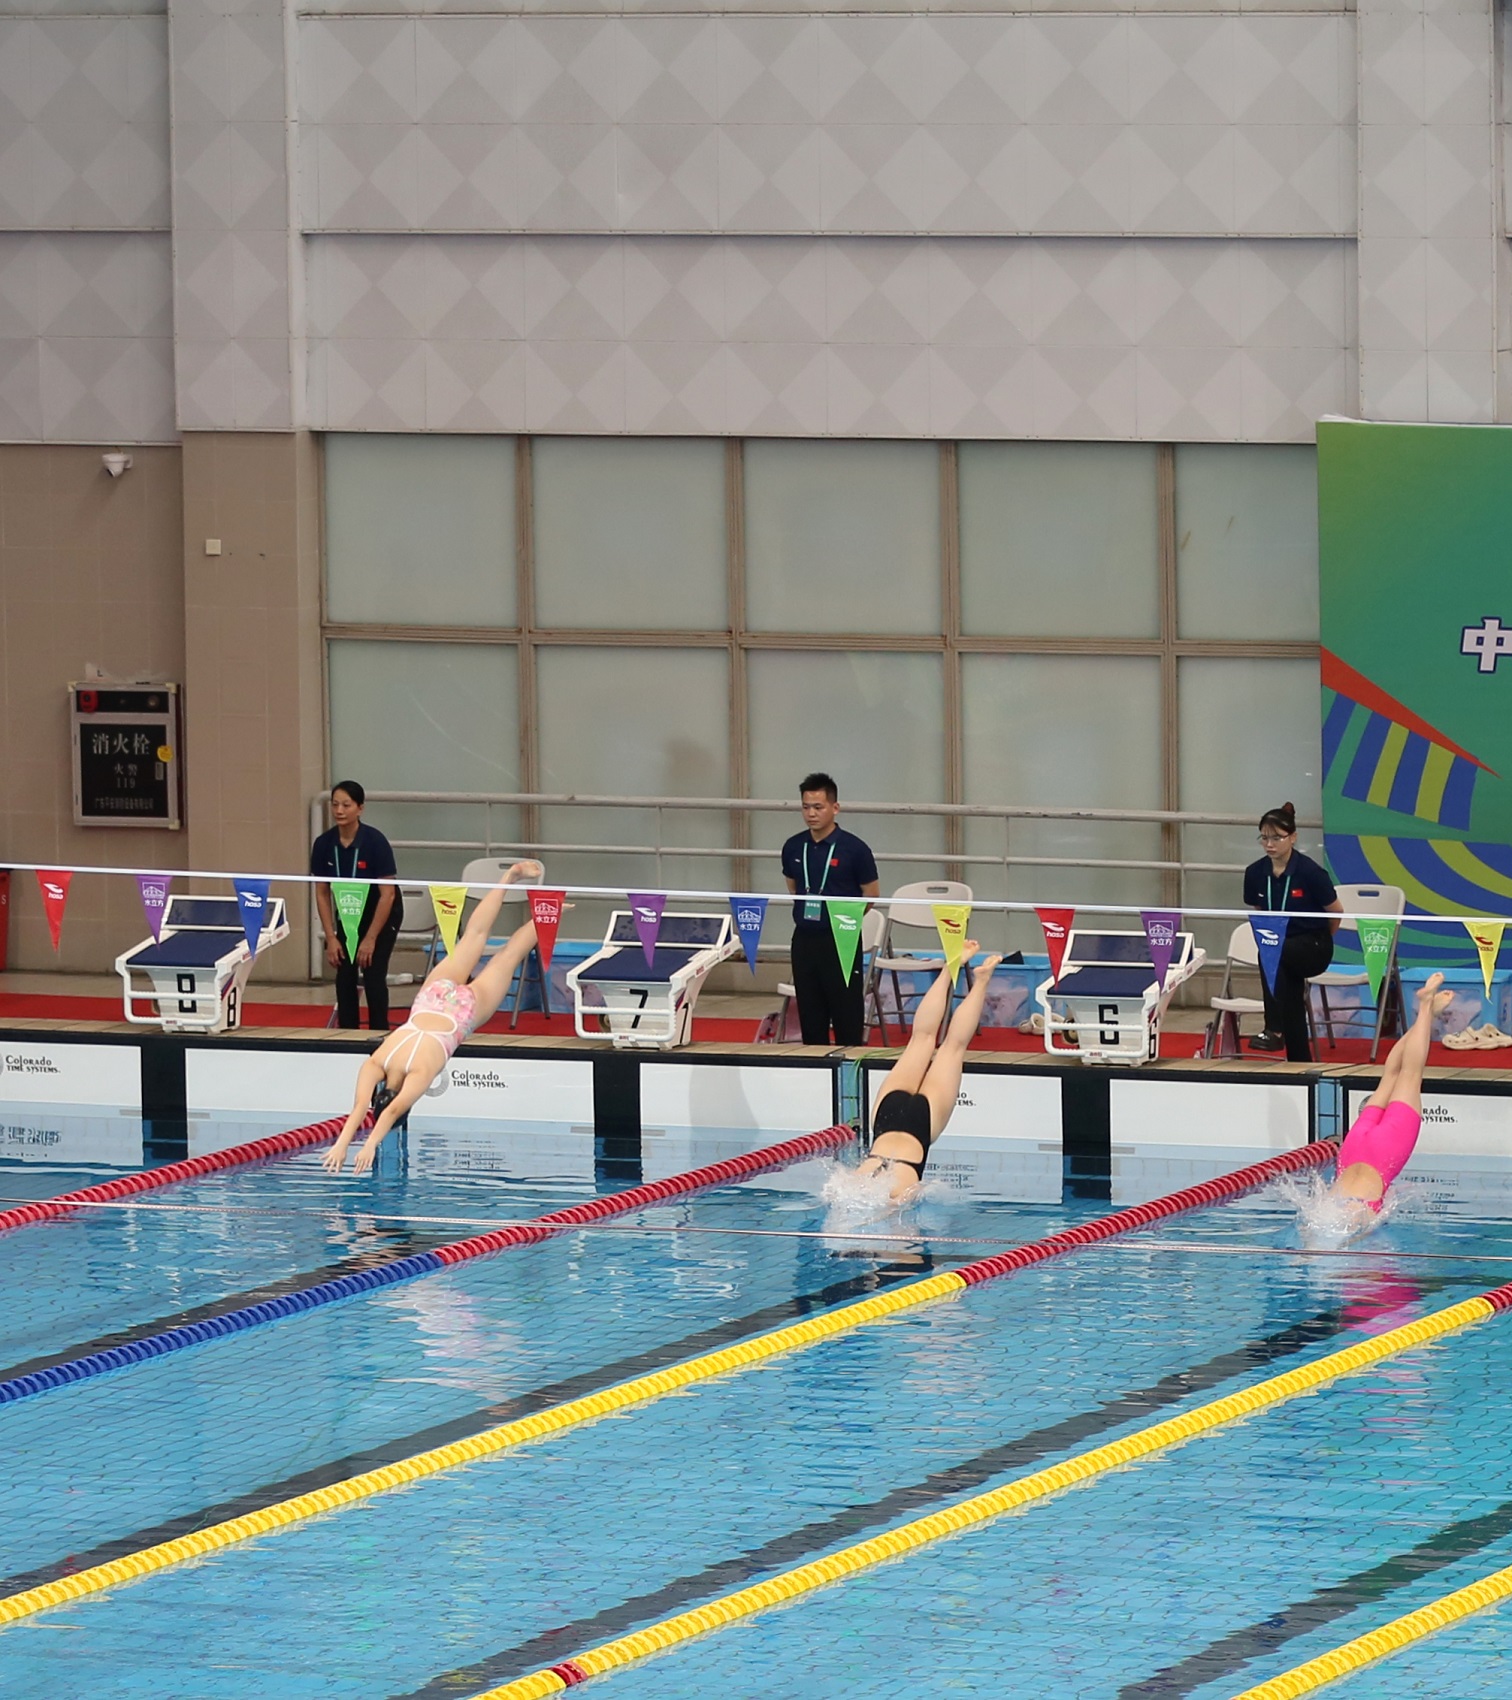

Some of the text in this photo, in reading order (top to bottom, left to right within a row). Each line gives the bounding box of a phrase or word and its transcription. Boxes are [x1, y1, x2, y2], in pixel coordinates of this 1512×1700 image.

[92, 732, 150, 755] 消火栓
[116, 777, 136, 789] 119
[48, 891, 64, 900] hosa
[144, 899, 164, 907] 水立方
[244, 900, 262, 908] hosa
[341, 907, 361, 915] 水立方
[441, 908, 457, 916] hosa
[535, 915, 558, 924] 水立方
[640, 915, 657, 923] hosa
[739, 923, 761, 931] 水立方
[839, 923, 857, 931] hosa
[1150, 938, 1173, 946] 水立方
[1261, 938, 1279, 946] hosa
[176, 973, 197, 1013] 8
[629, 988, 649, 1029] 7
[1098, 1004, 1120, 1045] 6
